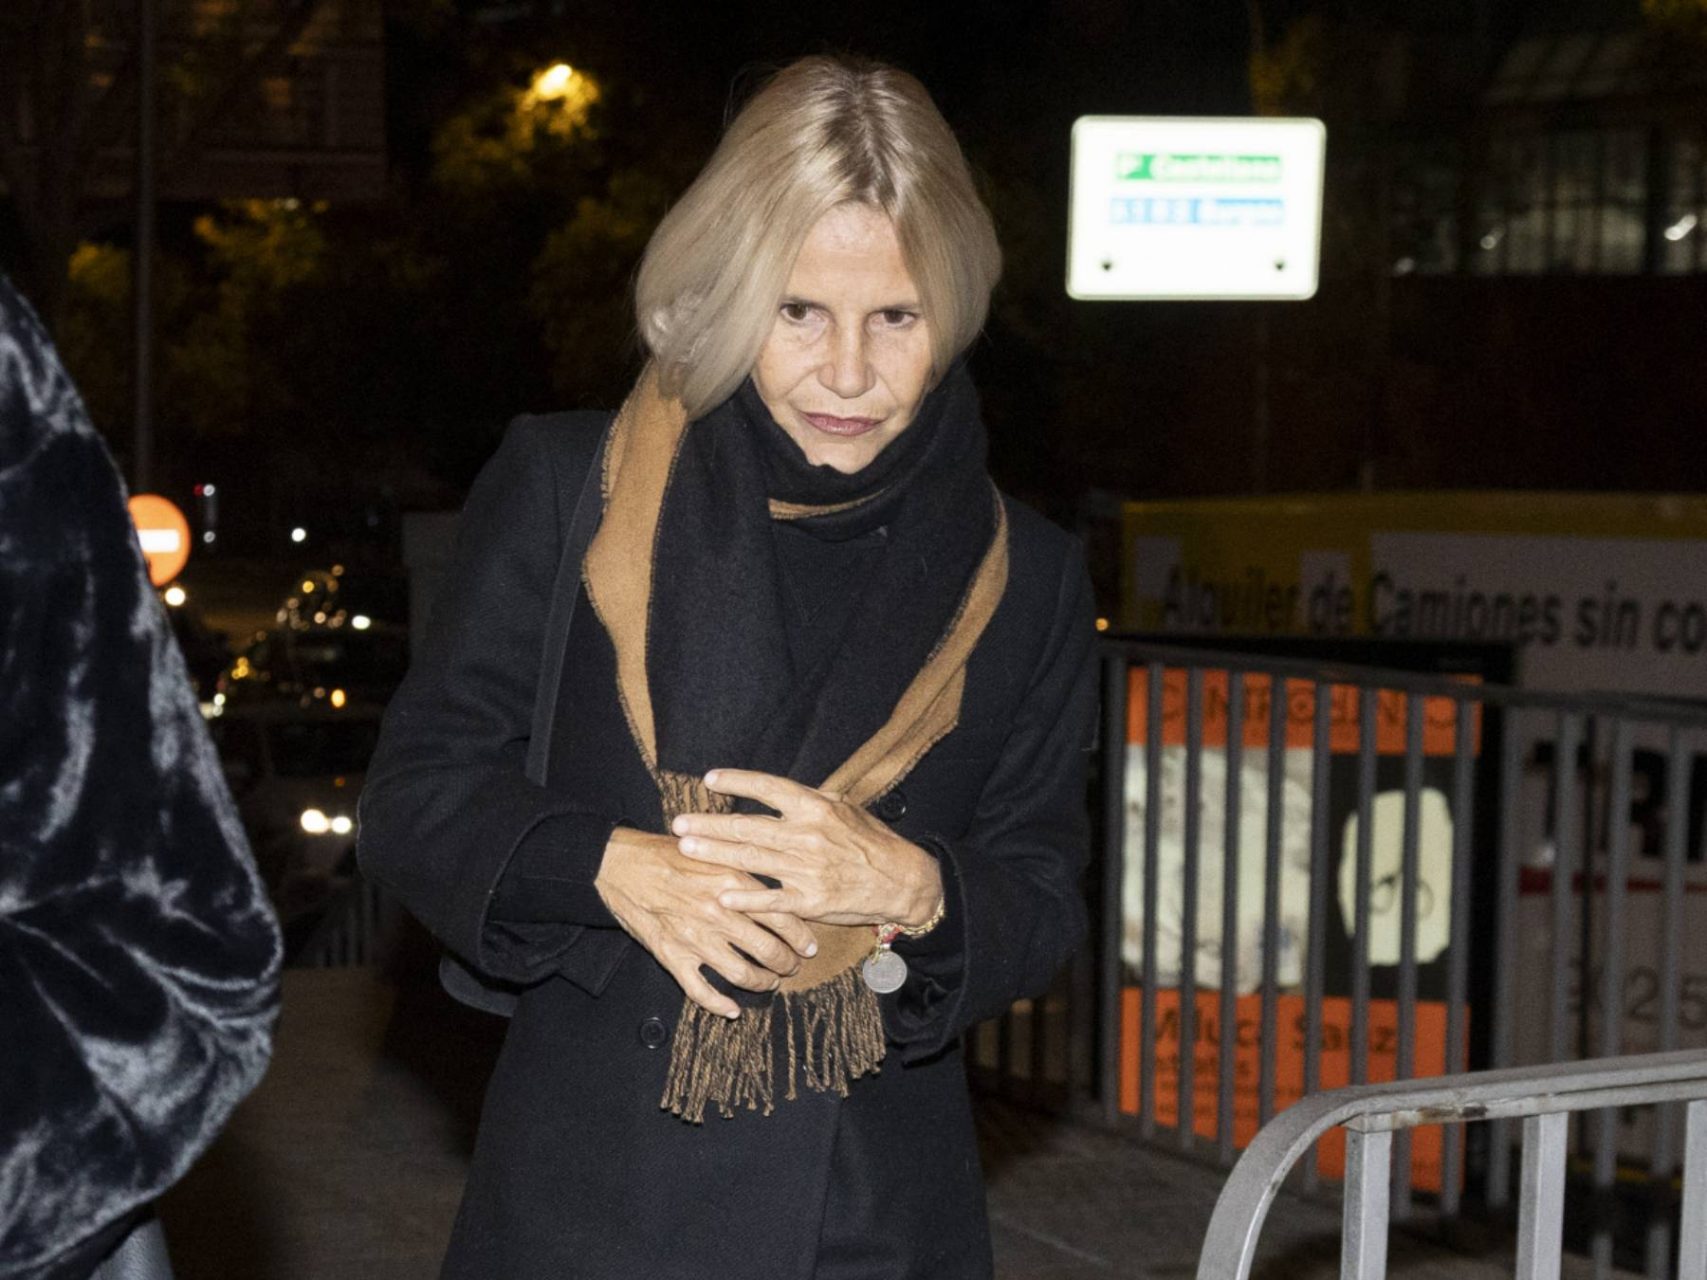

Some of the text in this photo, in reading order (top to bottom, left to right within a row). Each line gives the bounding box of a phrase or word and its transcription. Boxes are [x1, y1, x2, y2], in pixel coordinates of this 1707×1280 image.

[1309, 569, 1356, 634] de
[1366, 570, 1563, 646] Camiones
[1575, 579, 1641, 649] sin
